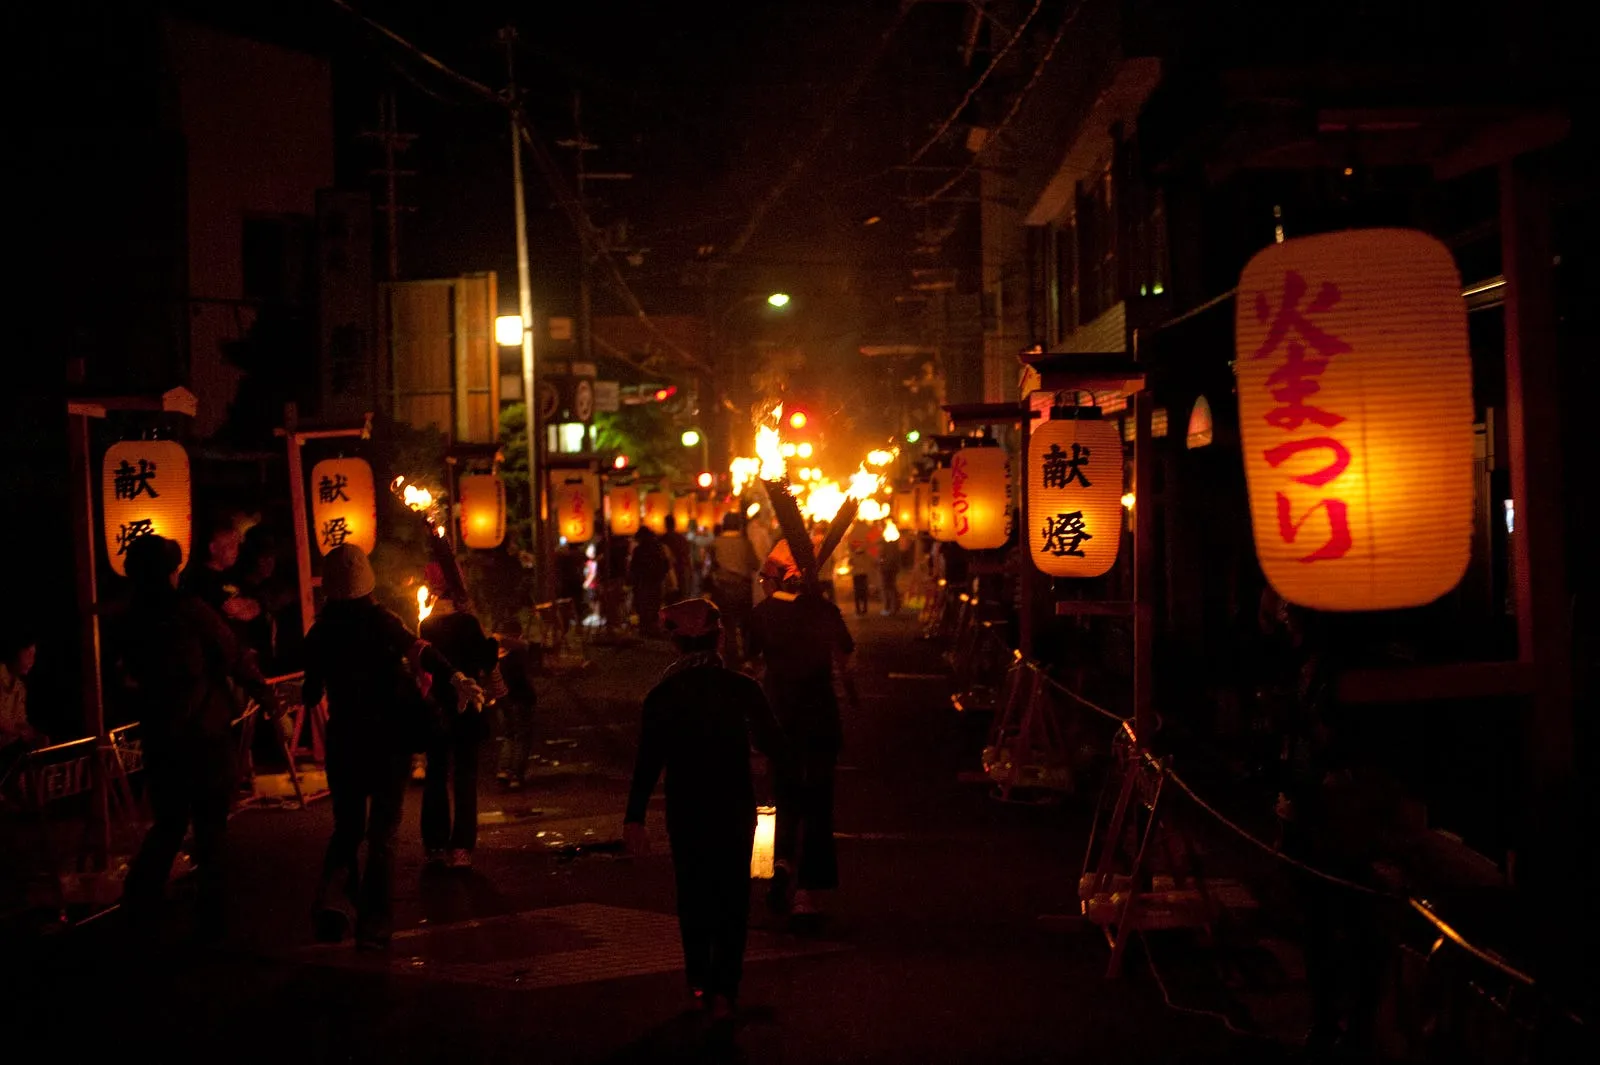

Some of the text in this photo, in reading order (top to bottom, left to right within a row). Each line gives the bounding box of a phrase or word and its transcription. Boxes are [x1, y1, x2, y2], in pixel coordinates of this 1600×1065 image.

[1255, 271, 1353, 563] 火まつり
[321, 475, 352, 547] 献燈
[1042, 443, 1092, 558] 献燈
